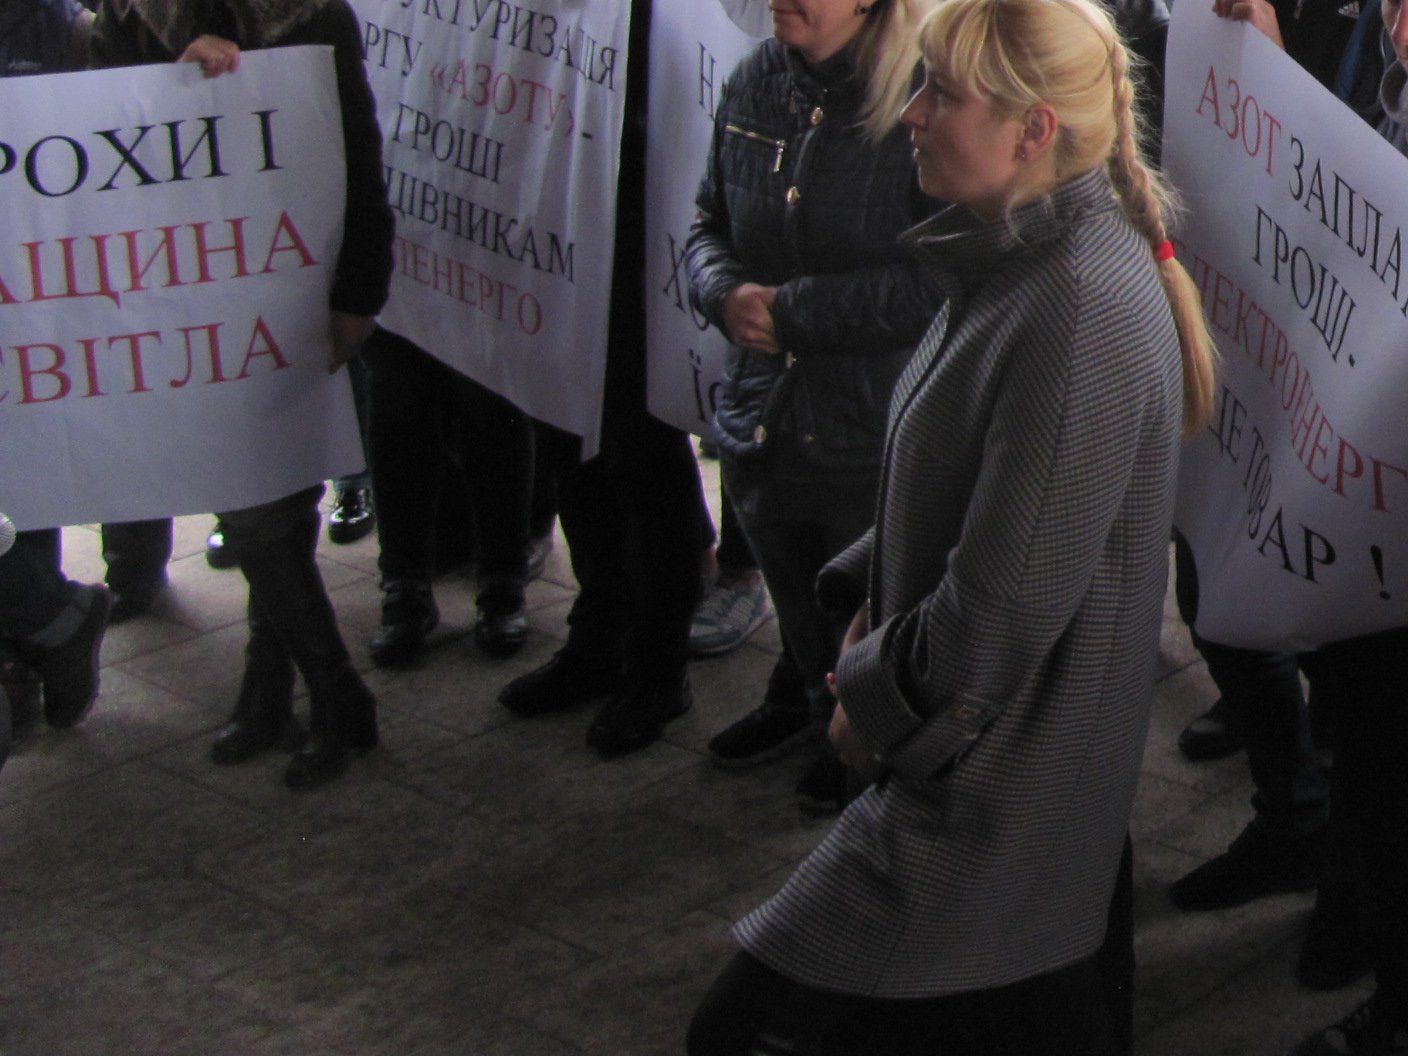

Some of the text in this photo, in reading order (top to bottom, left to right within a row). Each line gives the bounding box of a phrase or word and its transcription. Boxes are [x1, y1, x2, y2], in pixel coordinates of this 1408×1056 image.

[362, 22, 422, 77] РГУ
[392, 103, 505, 184] ГРОШІ
[1196, 66, 1281, 177] АЗОТ
[385, 166, 577, 285] ЦІВНИКАМ
[0, 315, 293, 407] ВІТЛА
